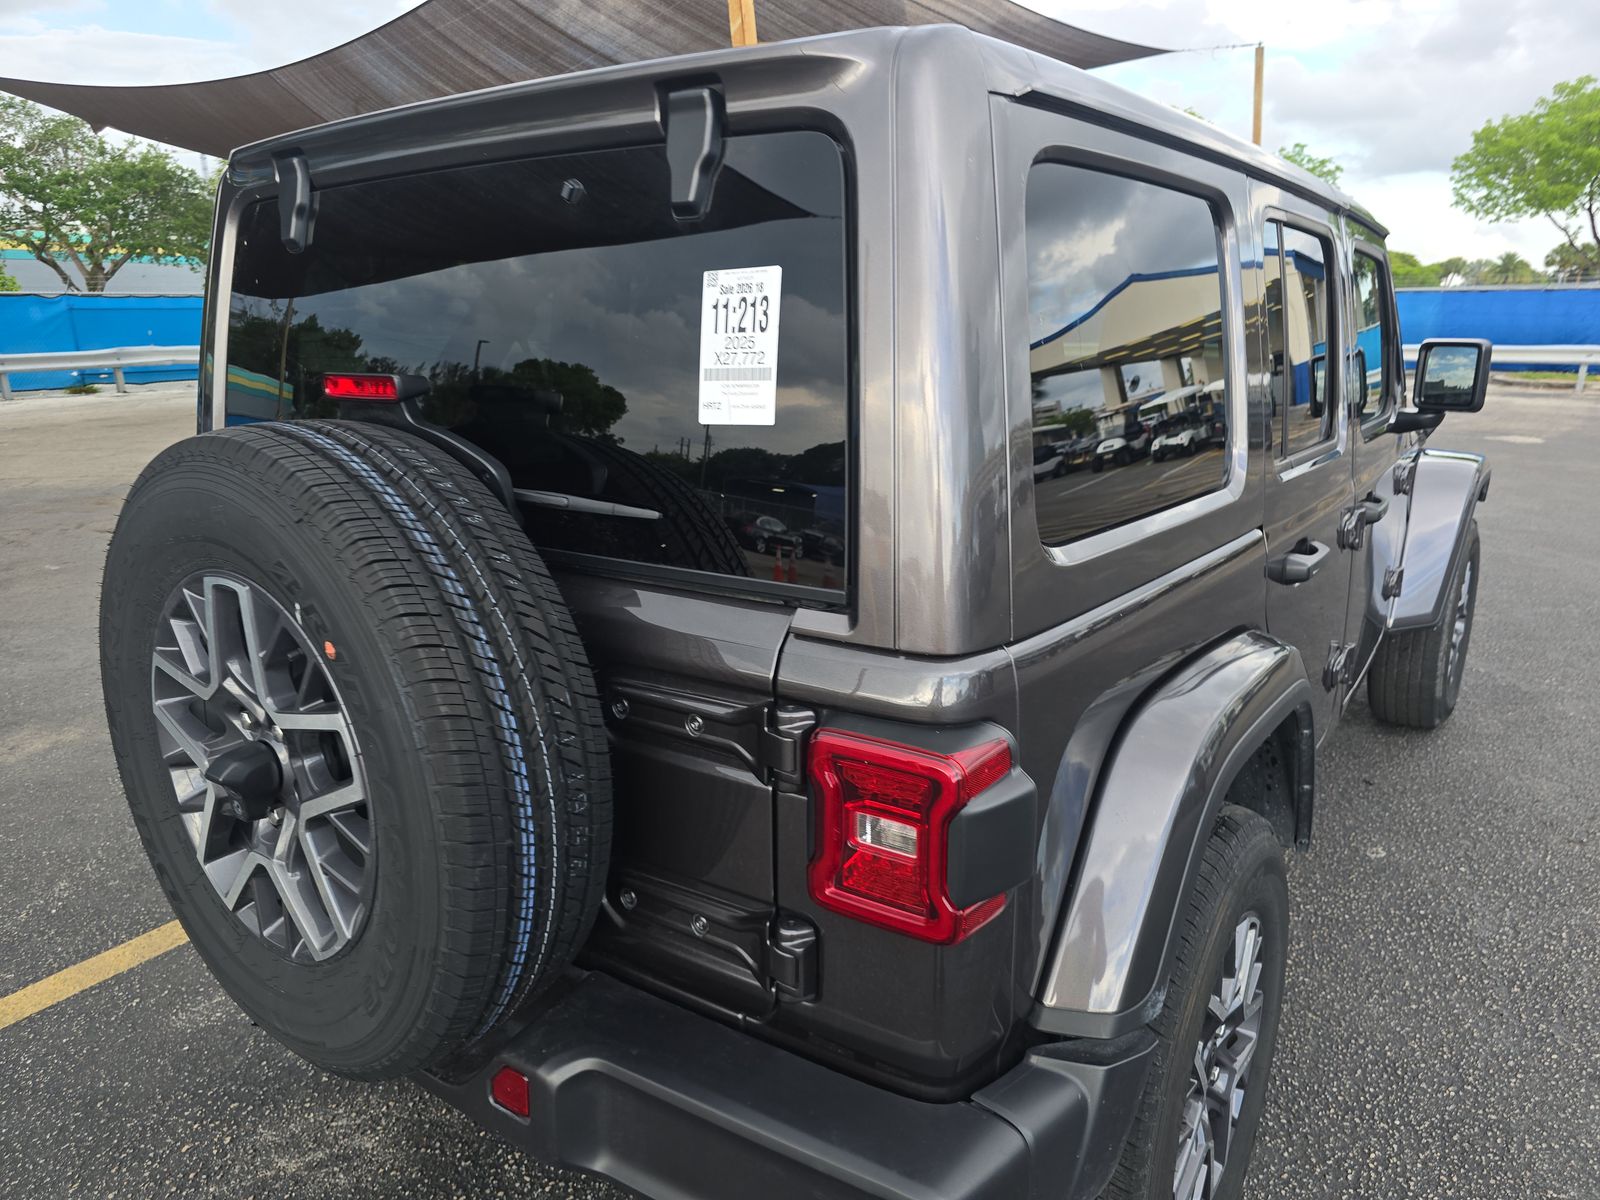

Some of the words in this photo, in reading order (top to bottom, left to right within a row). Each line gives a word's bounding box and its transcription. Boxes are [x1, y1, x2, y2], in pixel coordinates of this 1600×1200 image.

[719, 284, 735, 295] Sale
[712, 295, 769, 334] 11:213
[724, 335, 755, 349] 2025
